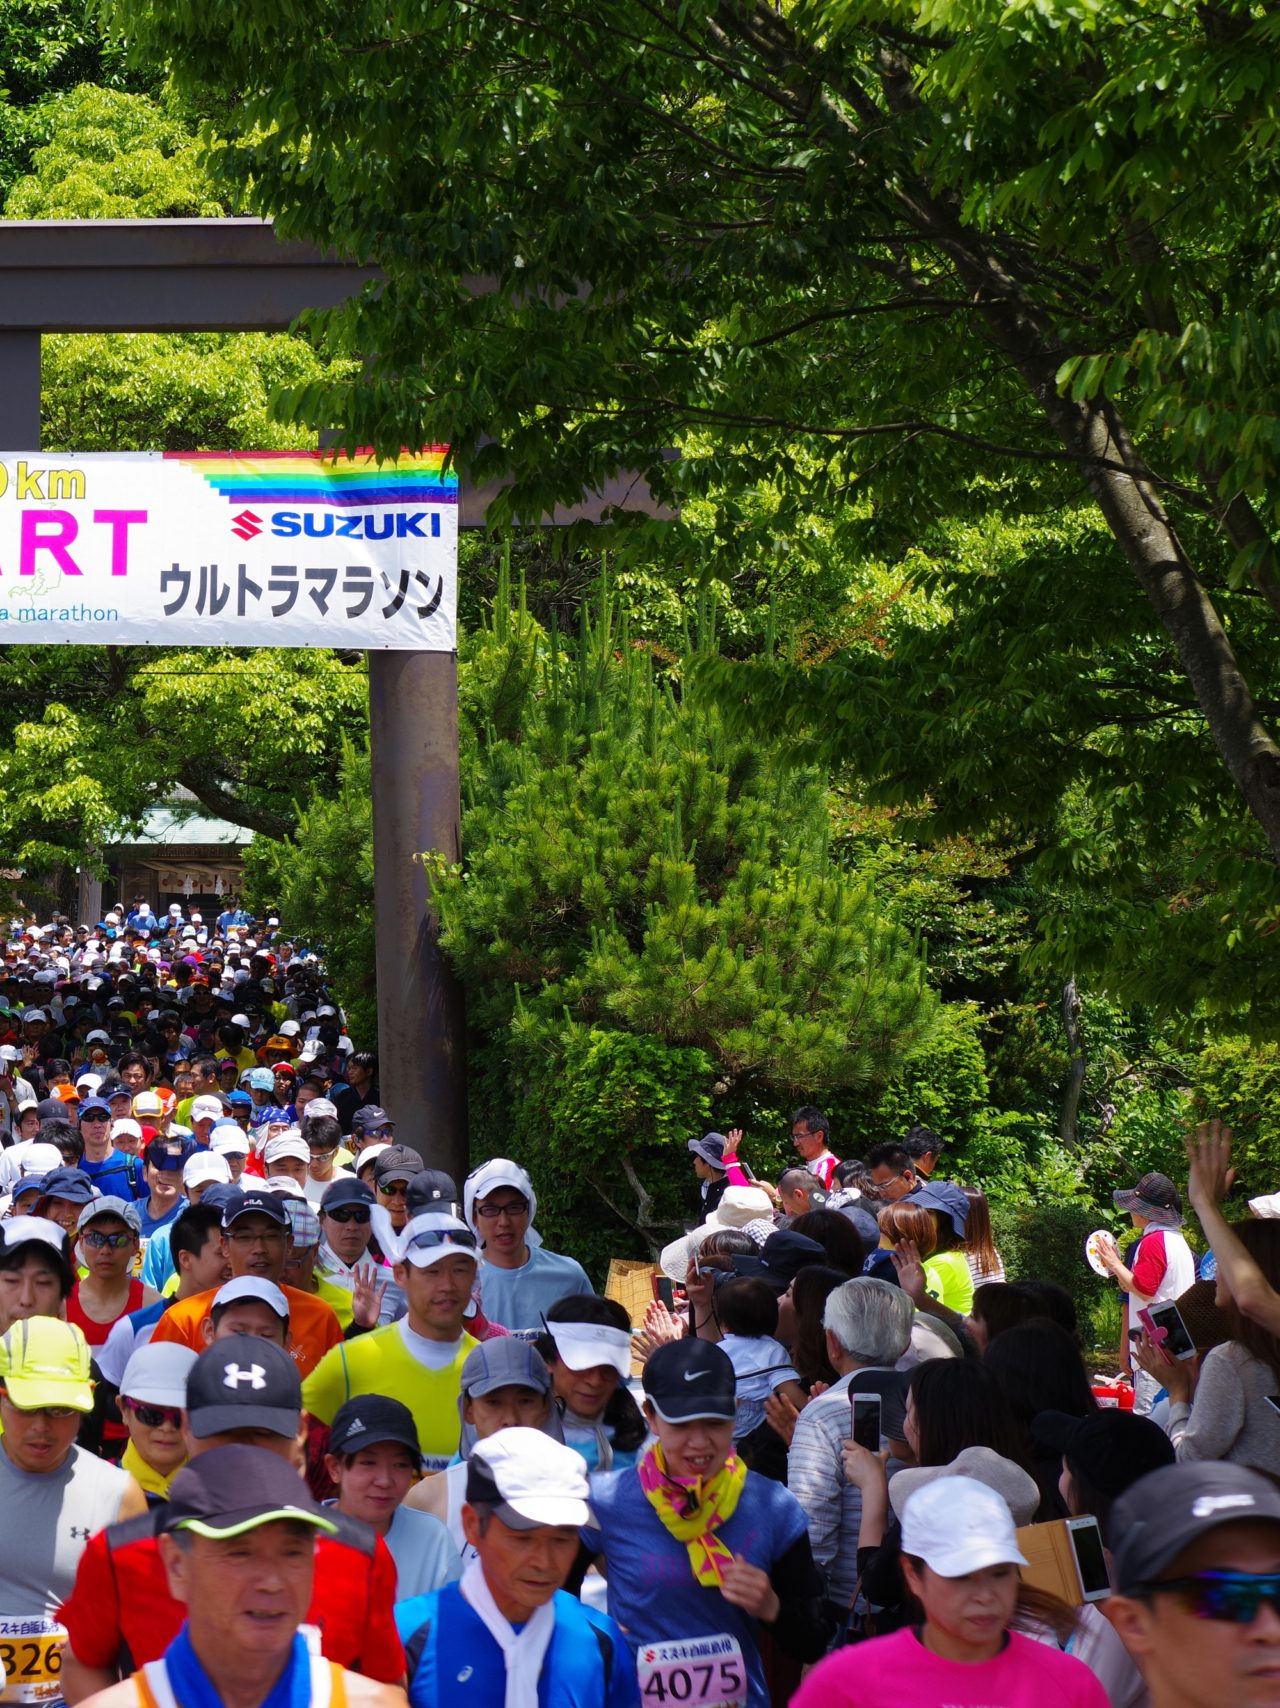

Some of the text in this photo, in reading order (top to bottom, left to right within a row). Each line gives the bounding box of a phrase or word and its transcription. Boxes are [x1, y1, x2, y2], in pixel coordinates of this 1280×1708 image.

[270, 511, 441, 540] SUZUKI
[160, 562, 444, 620] ウルトラマラソン
[18, 603, 119, 621] marathon
[643, 1661, 741, 1702] 4075
